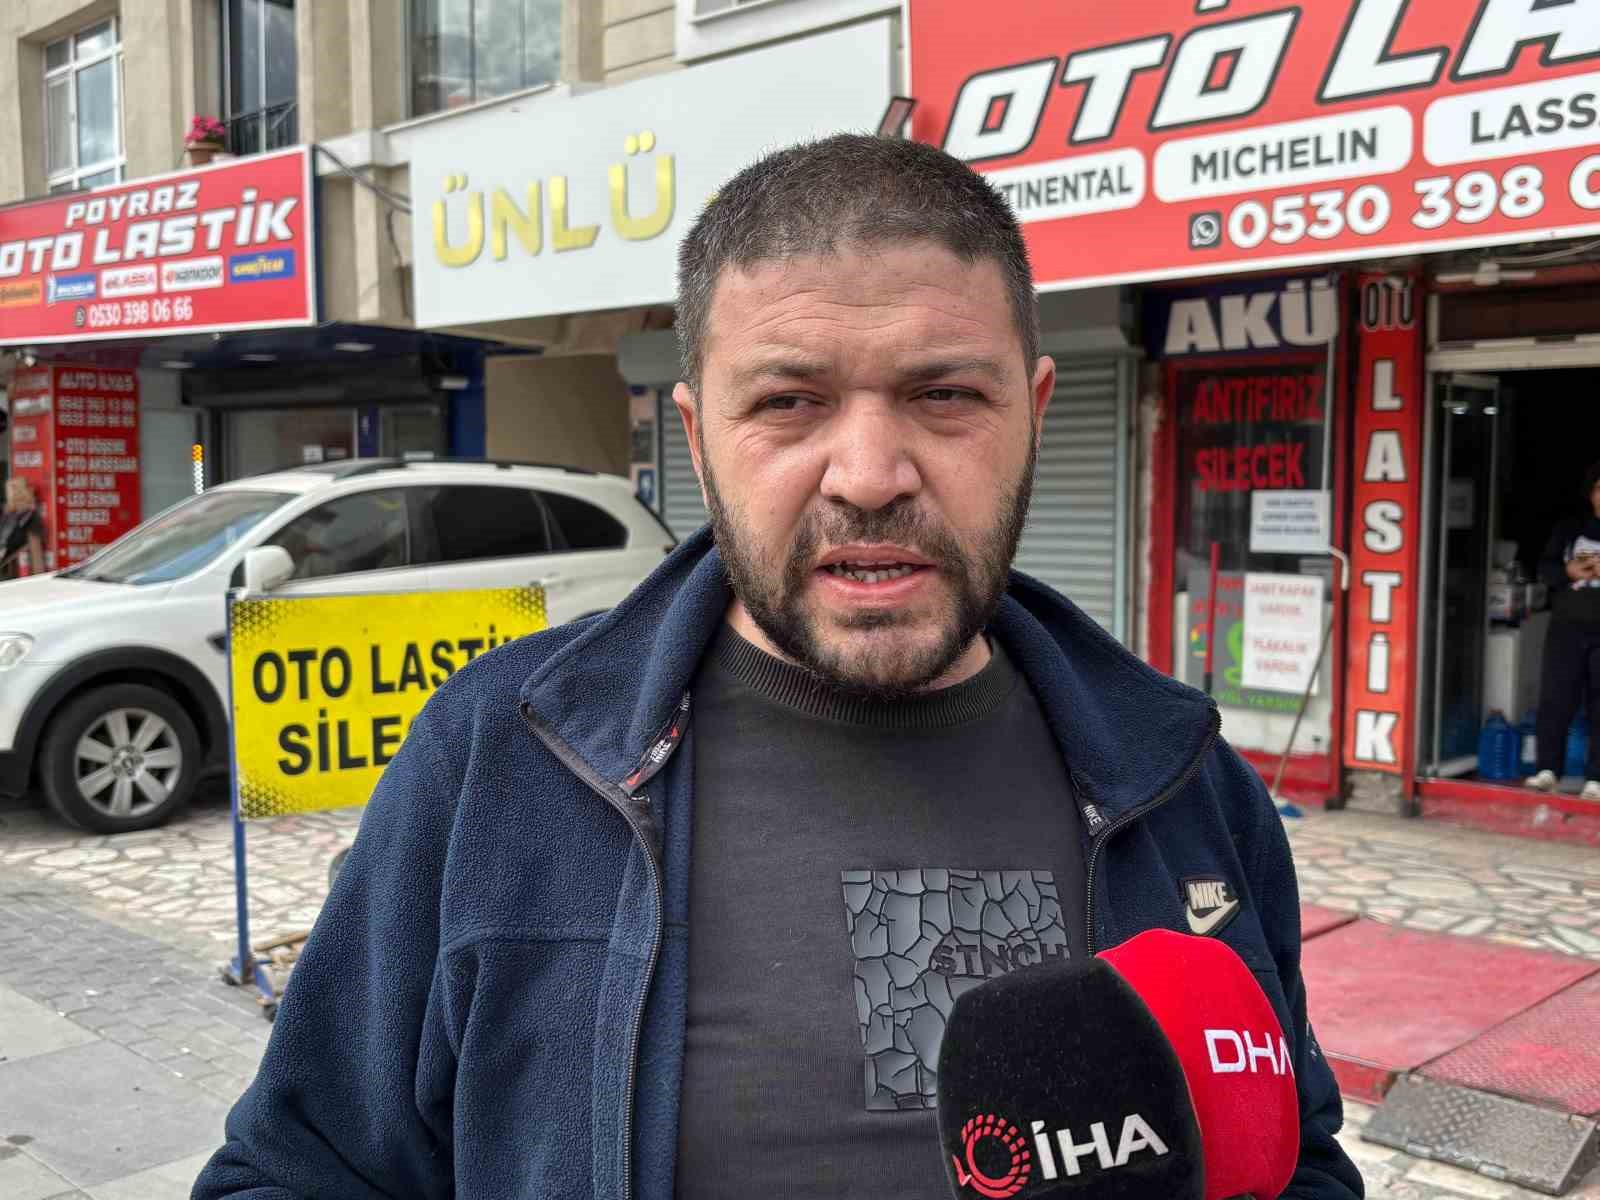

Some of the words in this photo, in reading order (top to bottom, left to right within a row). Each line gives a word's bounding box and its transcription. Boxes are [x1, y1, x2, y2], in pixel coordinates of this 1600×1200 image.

[943, 5, 1303, 163] OTO
[1470, 93, 1600, 144] LASS
[1190, 127, 1378, 185] MICHELIN
[0, 232, 84, 277] OTO
[93, 188, 298, 265] LASTİK
[65, 181, 200, 228] POYRAZ
[432, 130, 676, 268] ÜNLÜ
[1227, 184, 1391, 250] 0530
[1411, 164, 1545, 229] 398
[88, 303, 121, 328] 0530
[123, 300, 149, 326] 398
[152, 298, 171, 323] 06
[173, 295, 193, 322] 66
[1165, 276, 1339, 354] AKÜ
[1354, 359, 1407, 763] LASTİK
[252, 645, 351, 703] OTO
[277, 709, 415, 776] SİLE
[1082, 804, 1102, 826] NIKE
[1187, 881, 1228, 910] NIKE
[1031, 1112, 1170, 1181] İHA
